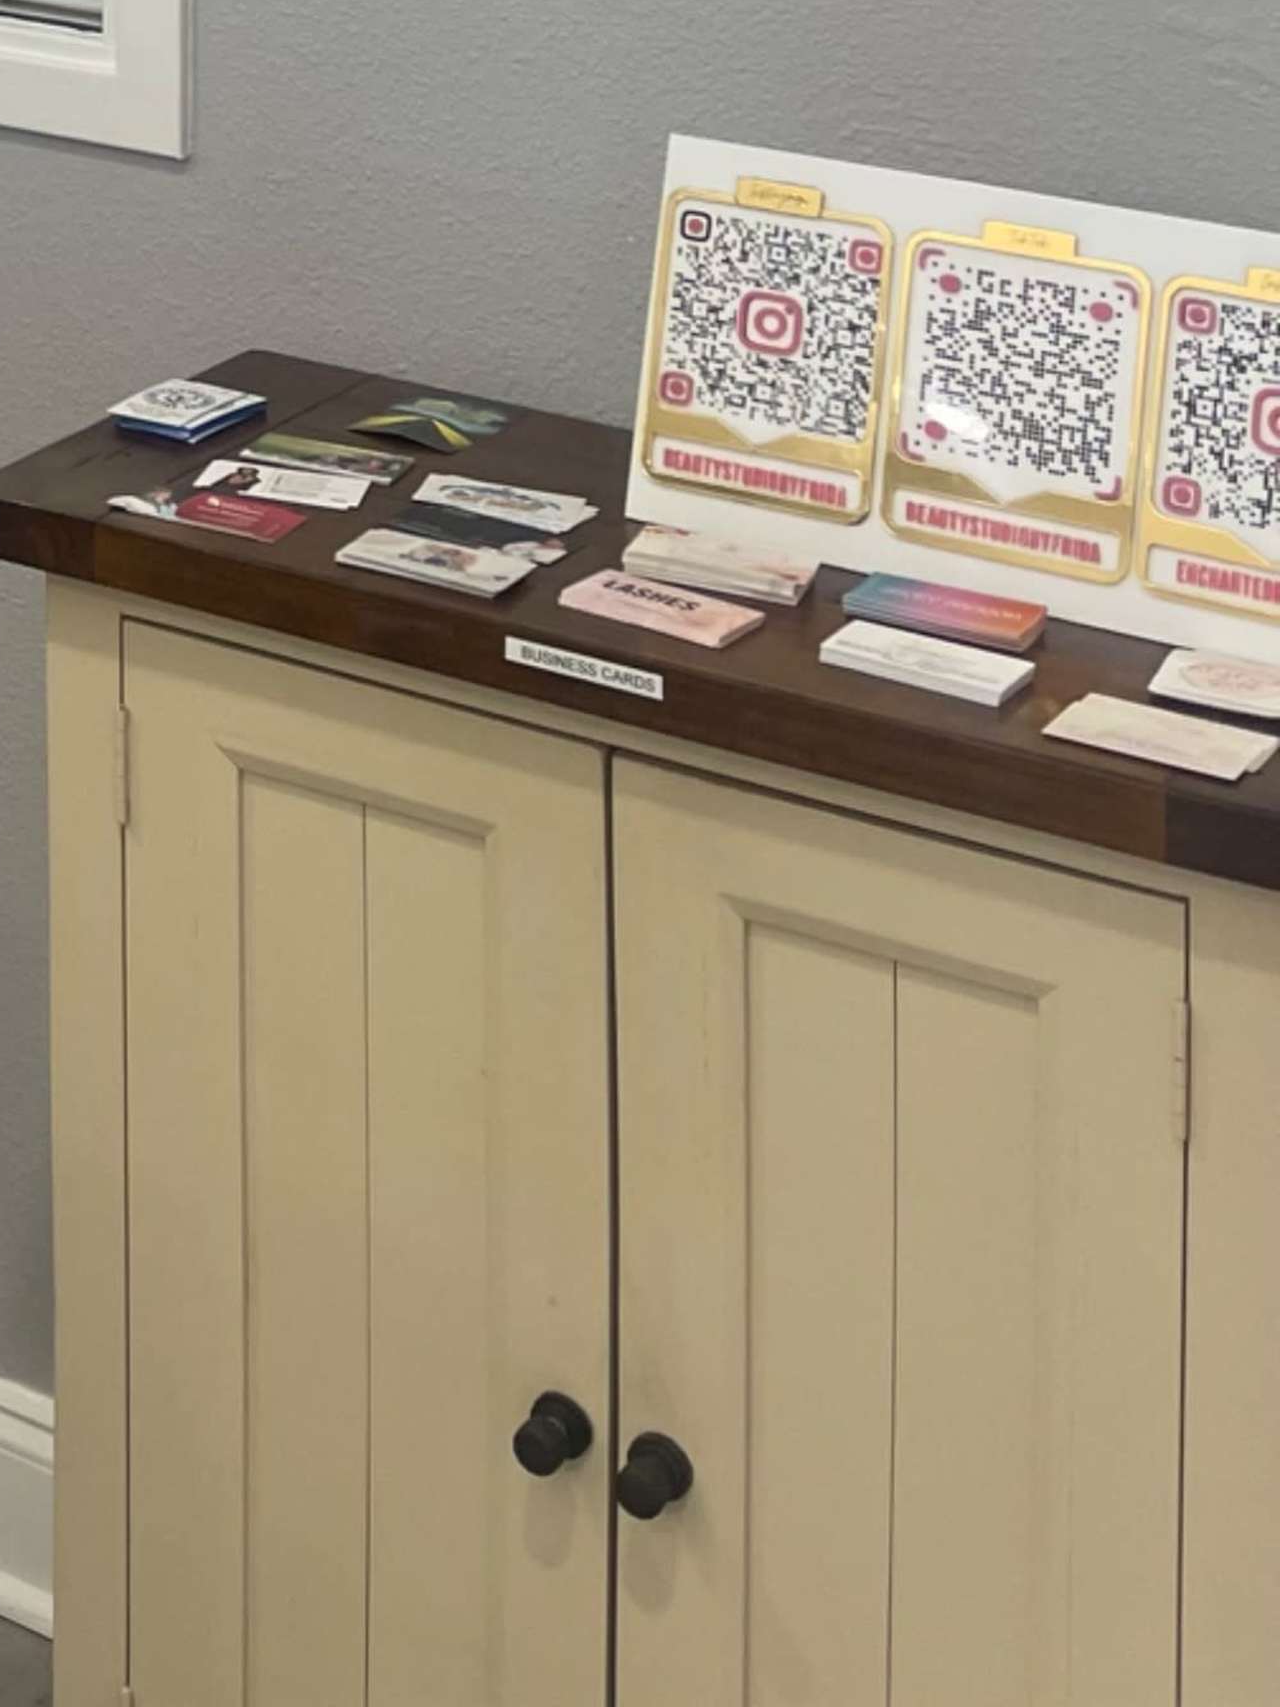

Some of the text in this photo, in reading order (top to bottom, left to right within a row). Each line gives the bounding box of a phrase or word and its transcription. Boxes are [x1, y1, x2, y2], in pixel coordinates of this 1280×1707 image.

[601, 577, 701, 612] LASHES
[520, 644, 657, 692] BUSINESS CARDS
